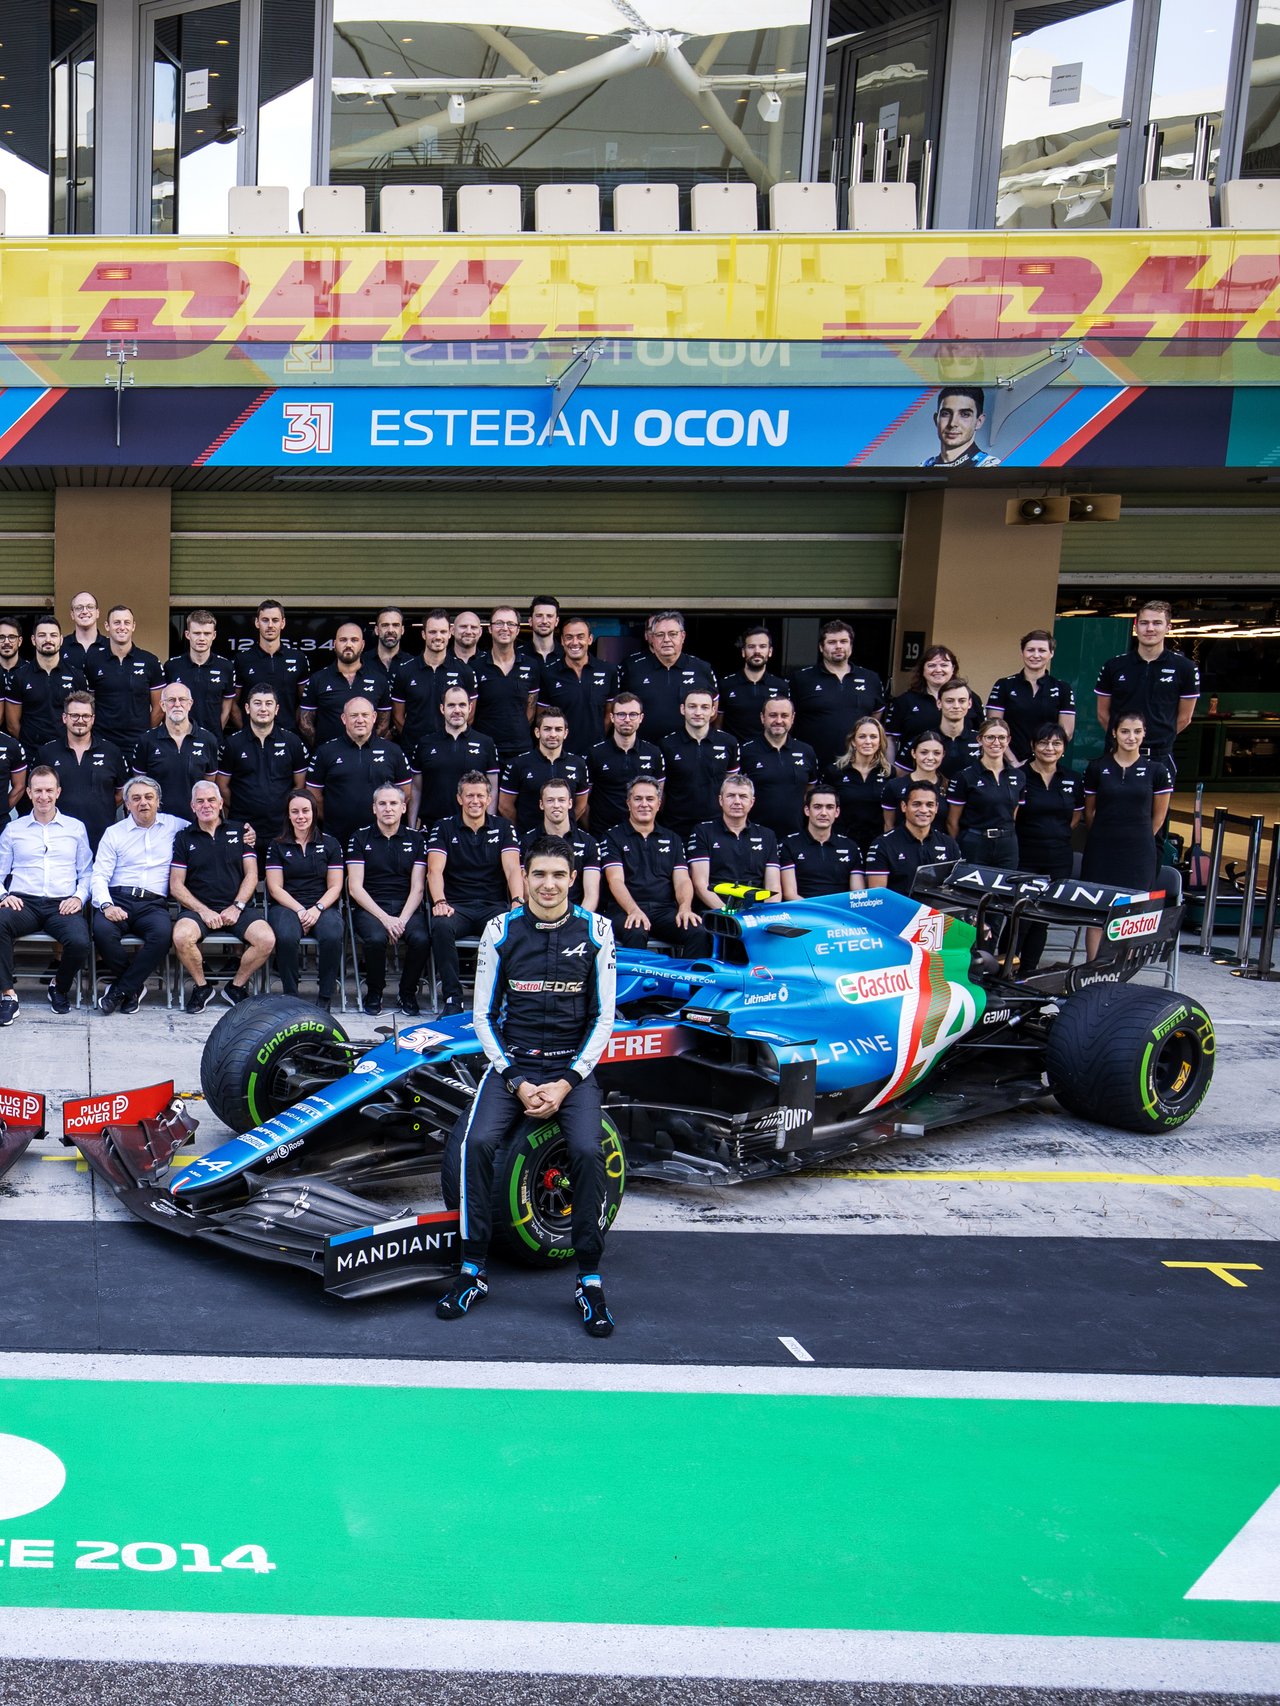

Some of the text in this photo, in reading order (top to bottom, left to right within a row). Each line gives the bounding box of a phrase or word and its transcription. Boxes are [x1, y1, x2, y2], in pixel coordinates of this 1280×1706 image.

[70, 260, 547, 360] DHL
[908, 254, 1280, 357] DH
[282, 402, 790, 453] 31 ESTEBAN OCON
[906, 643, 920, 659] 19
[849, 891, 868, 900] Delphi
[849, 898, 884, 909] Technologies
[756, 912, 791, 924] Microsoft
[1120, 914, 1159, 937] Castrol
[827, 927, 869, 939] RENAULT
[918, 914, 945, 951] 31
[815, 938, 883, 956] E-TECH
[631, 967, 717, 985] ALPINECARS.COM
[857, 968, 914, 999] Castrol
[744, 992, 777, 1005] ultimate
[1152, 1005, 1188, 1040] PIRELLI
[256, 1020, 325, 1065] Cinturato
[67, 1111, 110, 1128] POWER
[80, 1101, 110, 1116] PLUG
[527, 1121, 561, 1150] PIRE
[265, 1151, 279, 1165] Bell
[288, 1138, 305, 1152] Ross
[337, 1232, 457, 1273] MANDIANT
[75, 1541, 277, 1575] 2014
